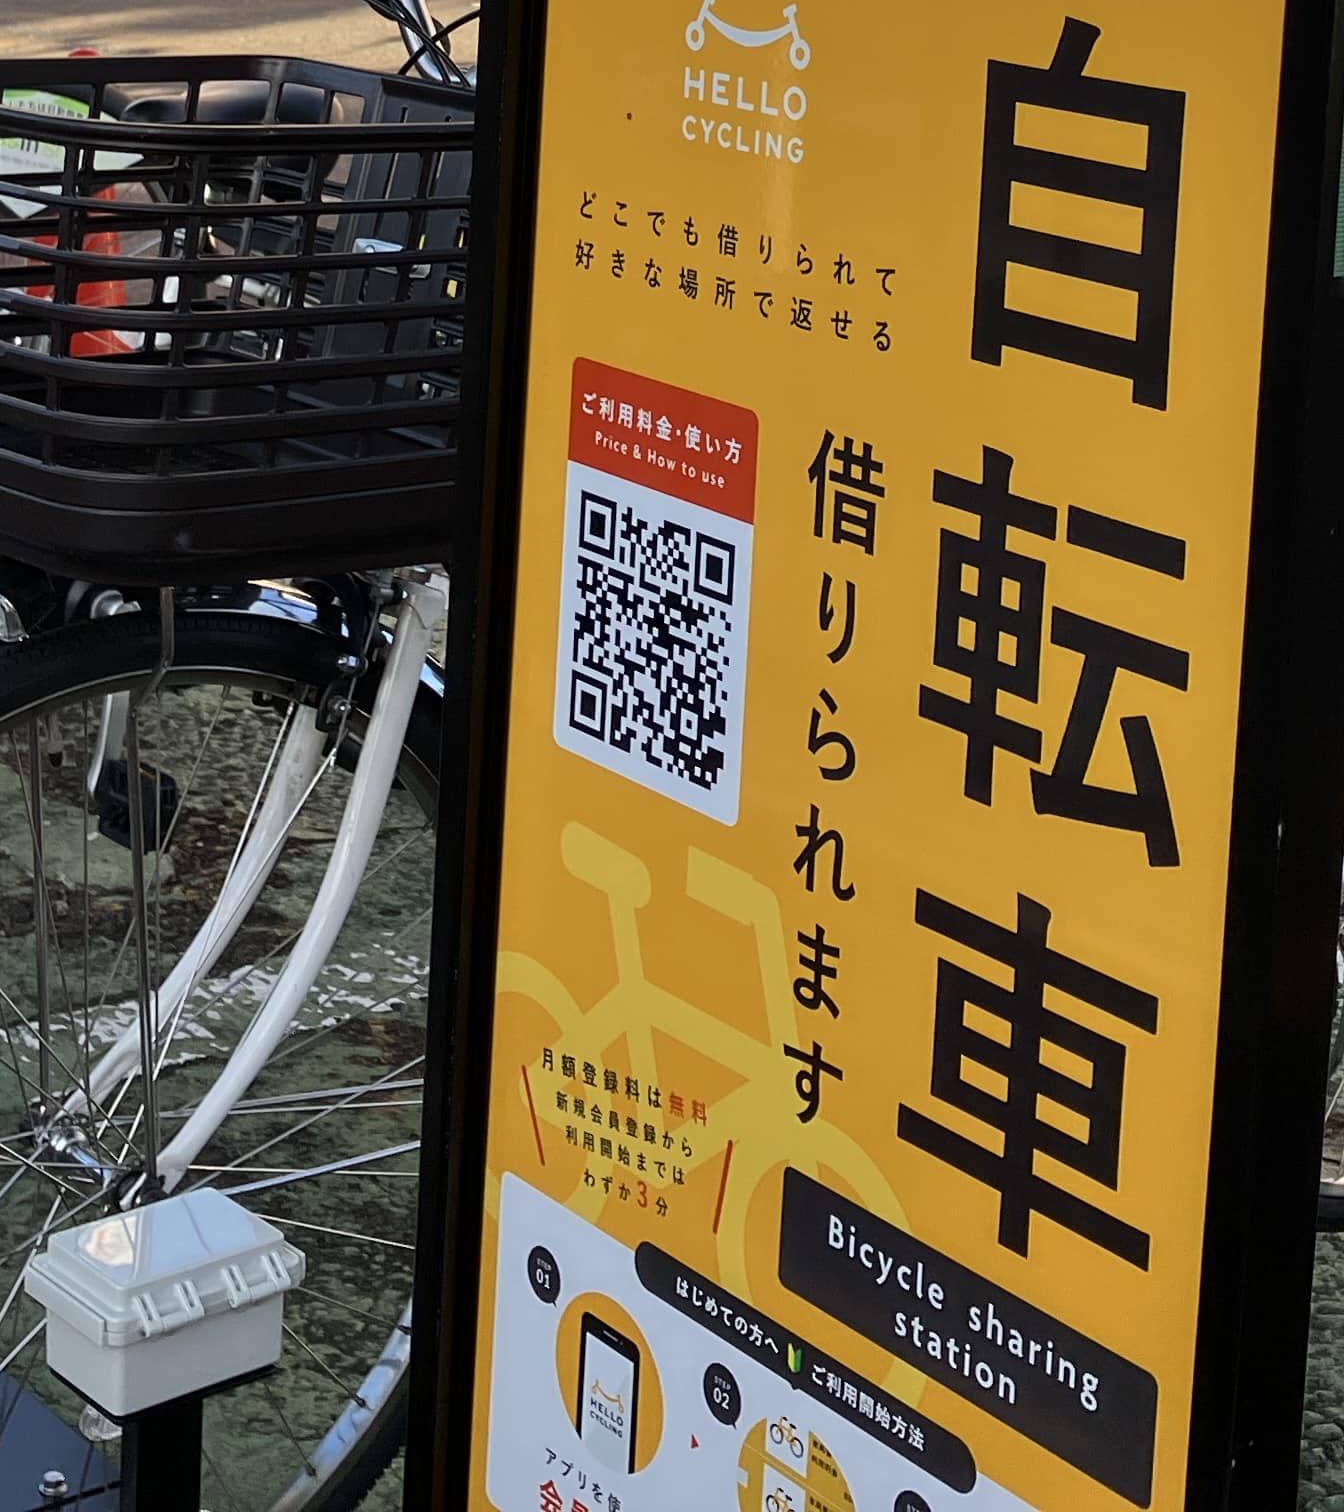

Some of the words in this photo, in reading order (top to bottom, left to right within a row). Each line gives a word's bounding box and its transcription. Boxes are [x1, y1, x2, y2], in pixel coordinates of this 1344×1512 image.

[682, 66, 808, 121] HELLO
[681, 115, 805, 164] CYCLING
[579, 190, 897, 296] どこでも借りられて
[575, 238, 892, 352] 好きな場所で返せる
[581, 392, 743, 465] ご利用料金・使い方
[594, 430, 628, 456] Price
[632, 443, 642, 460] &
[647, 448, 677, 472] How
[681, 461, 697, 478] to
[701, 470, 726, 489] use
[896, 15, 1191, 1273] 自転車
[782, 429, 886, 1124] 借りられます
[542, 1047, 707, 1127] 月額登録料は無料
[556, 1090, 693, 1158] 新規会員登録から
[565, 1124, 685, 1186] 利用開始までは
[583, 1167, 669, 1218] わずか3分
[536, 1268, 551, 1289] 01
[827, 1212, 947, 1312] Bicycle
[967, 1297, 1101, 1413] sharing
[674, 1274, 781, 1355] はじめての方へ
[810, 1363, 926, 1453] ご利用開始方法
[893, 1308, 1018, 1408] station
[589, 1410, 623, 1439] CYCLING
[590, 1397, 624, 1427] HELLO
[713, 1387, 729, 1410] 02
